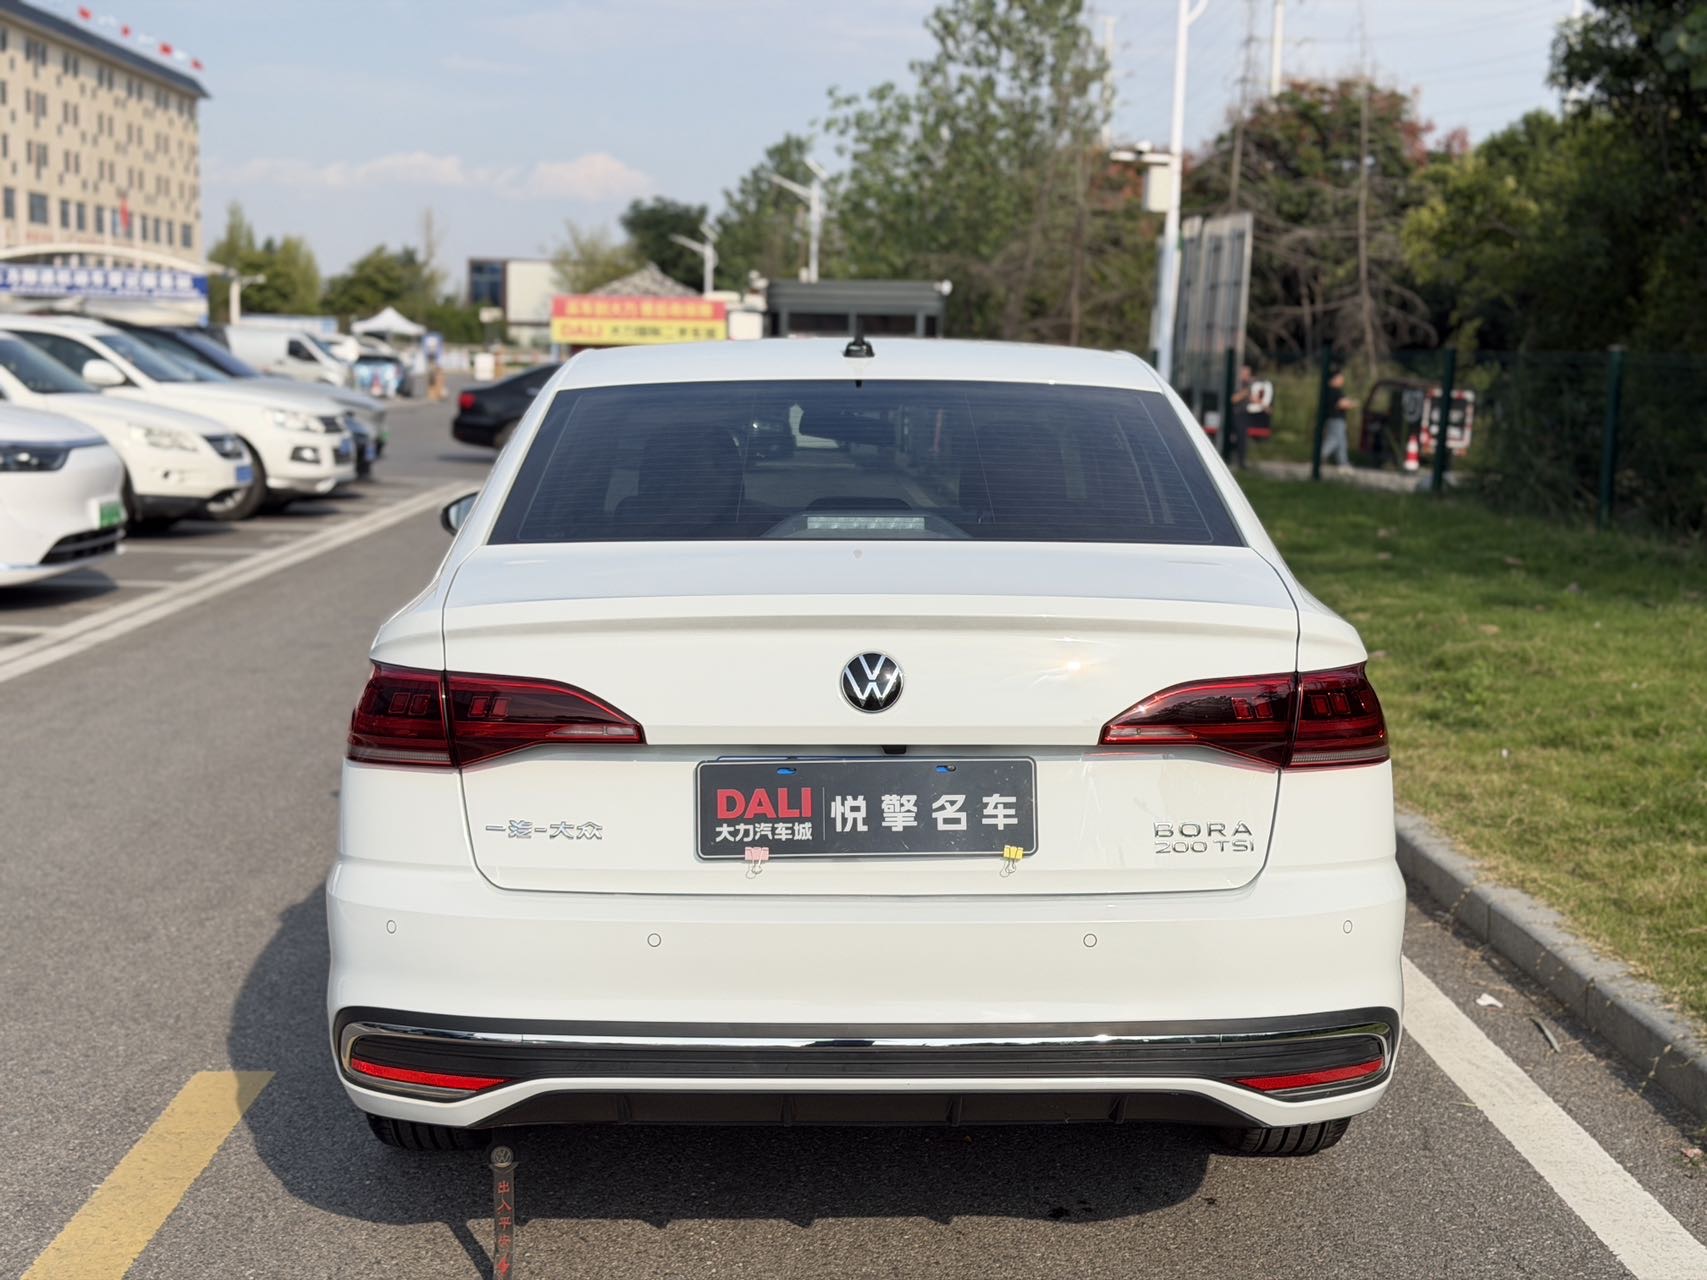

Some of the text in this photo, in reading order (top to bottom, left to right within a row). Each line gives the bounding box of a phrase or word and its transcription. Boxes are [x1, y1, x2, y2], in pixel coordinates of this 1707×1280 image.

[716, 787, 812, 819] DALI
[830, 793, 1019, 832] 悦擎名车
[715, 822, 813, 842] 大力汽车城
[1153, 820, 1253, 838] BORA
[1155, 841, 1208, 853] 200
